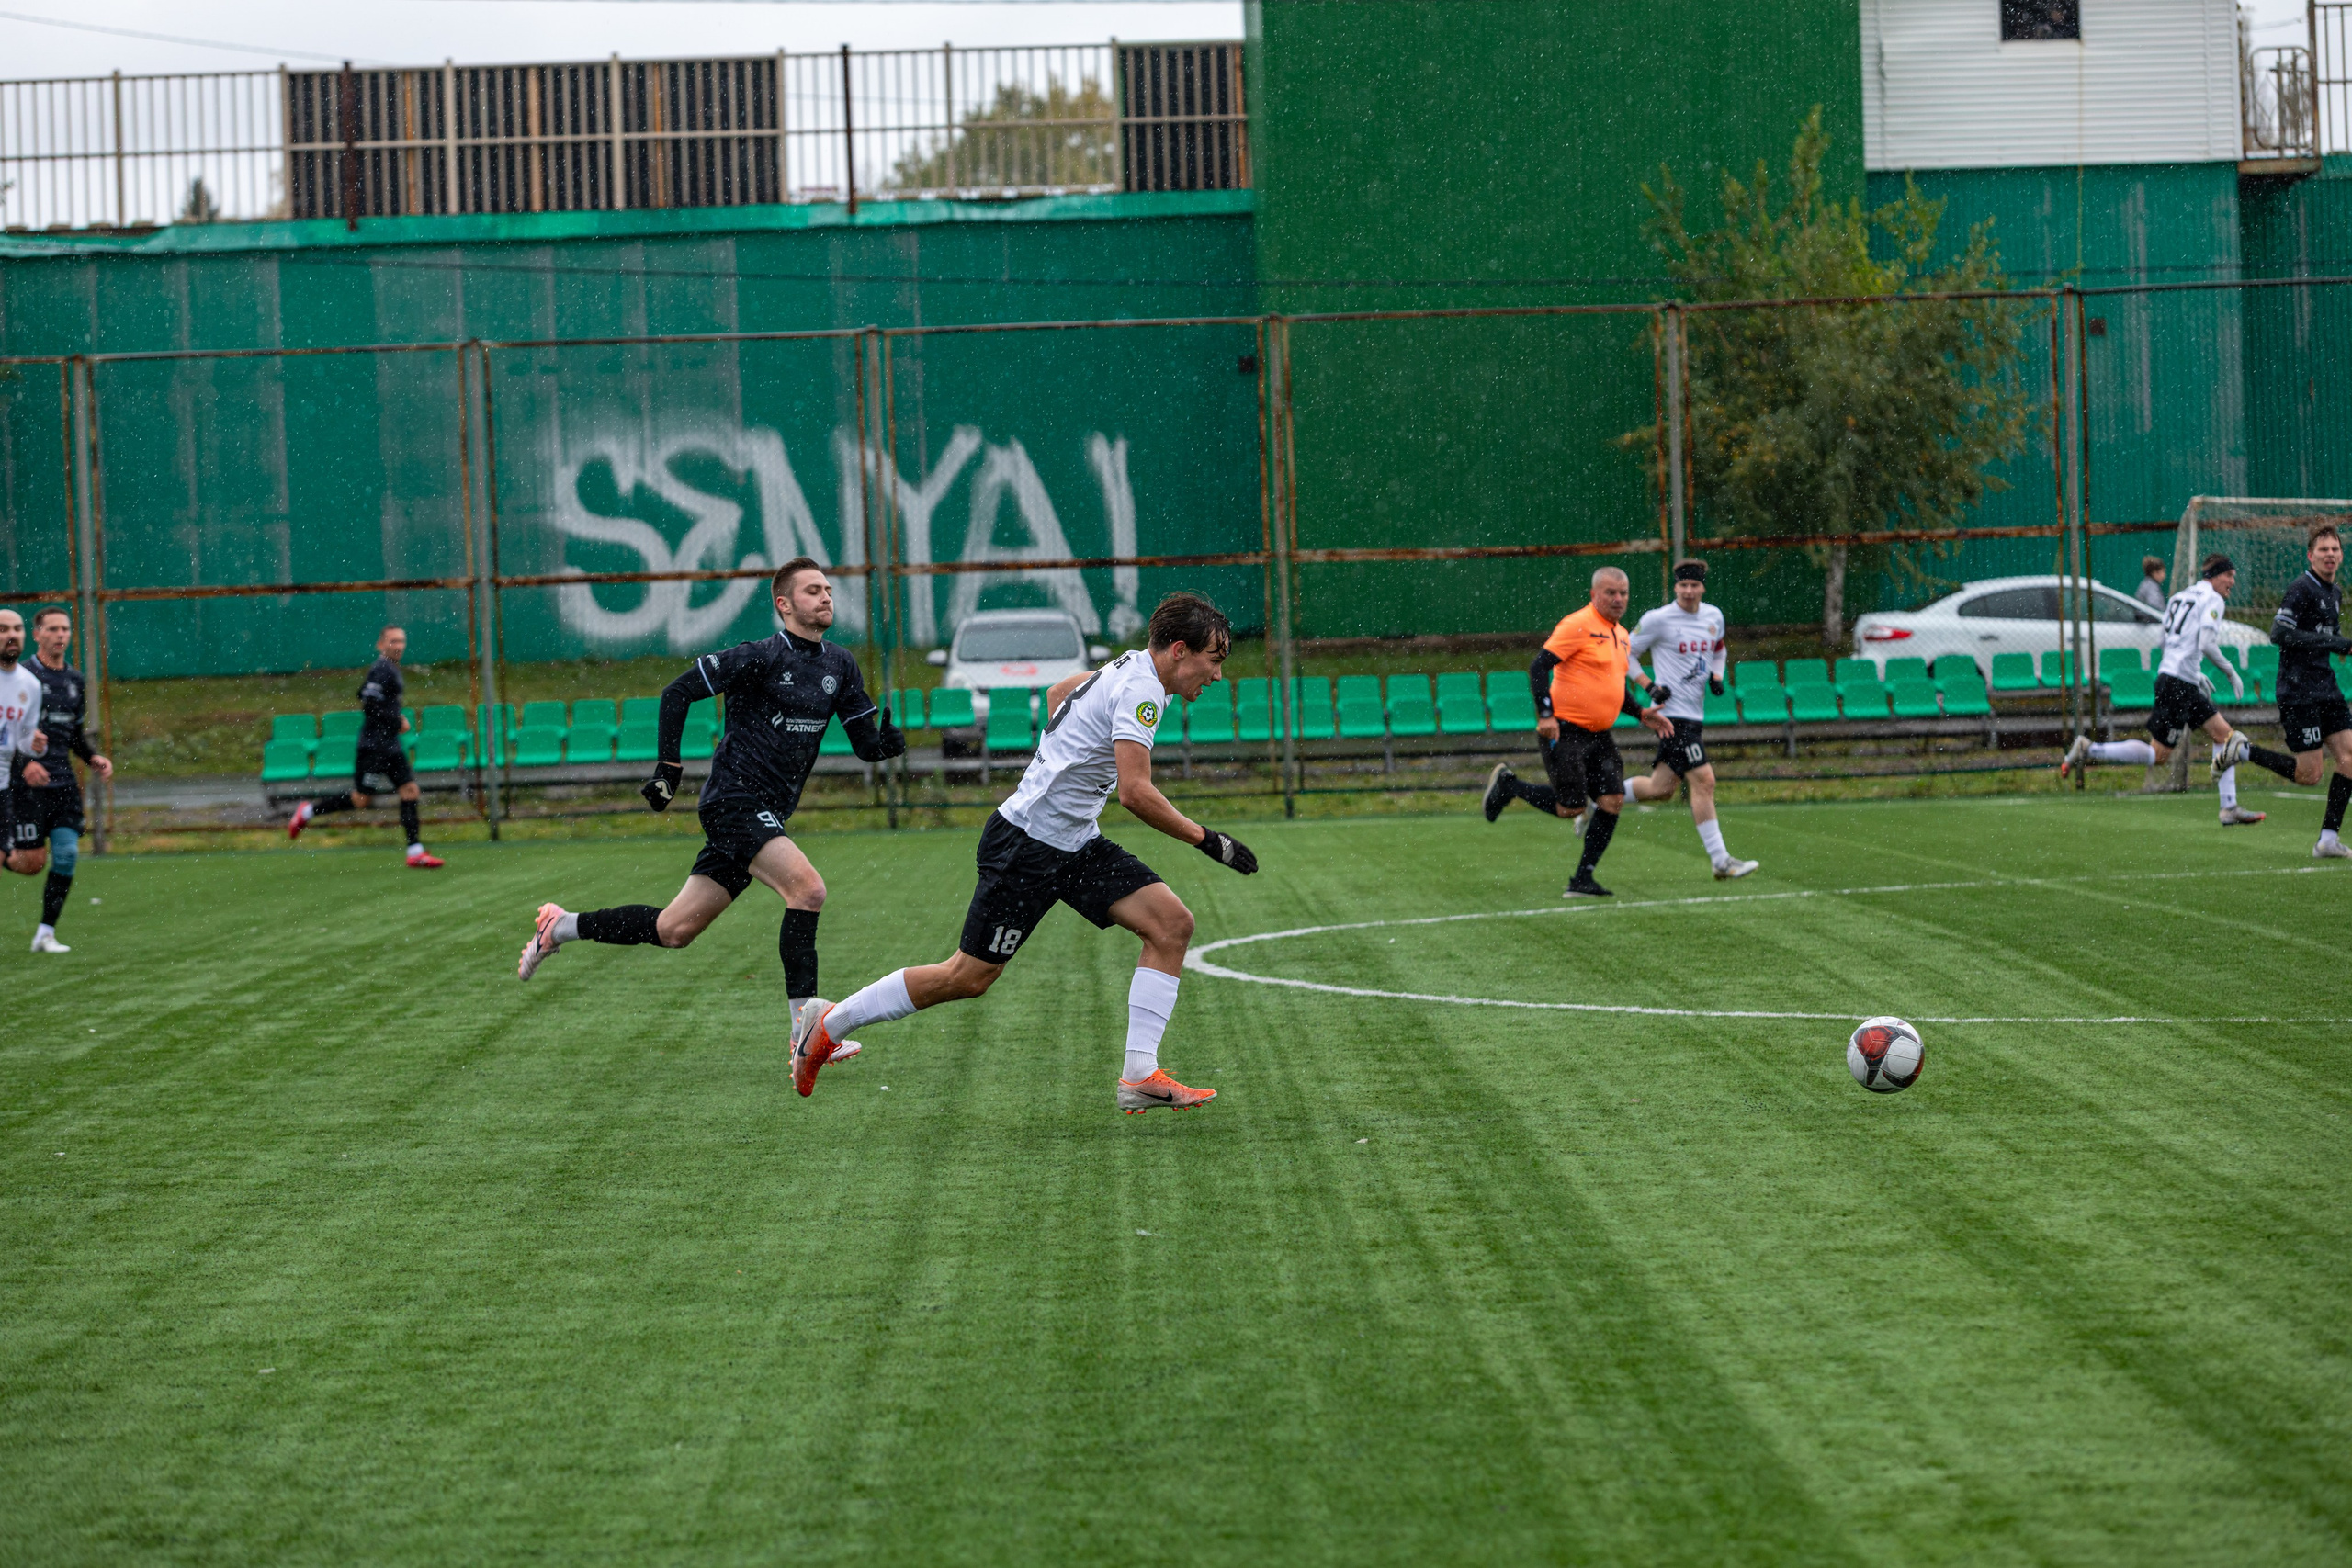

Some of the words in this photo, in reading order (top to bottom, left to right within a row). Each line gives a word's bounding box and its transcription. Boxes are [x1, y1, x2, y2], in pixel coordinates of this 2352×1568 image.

[2165, 599, 2195, 635] 87
[2302, 727, 2321, 744] 30
[1685, 743, 1702, 763] 10
[16, 823, 38, 842] 10
[989, 925, 1022, 955] 18
